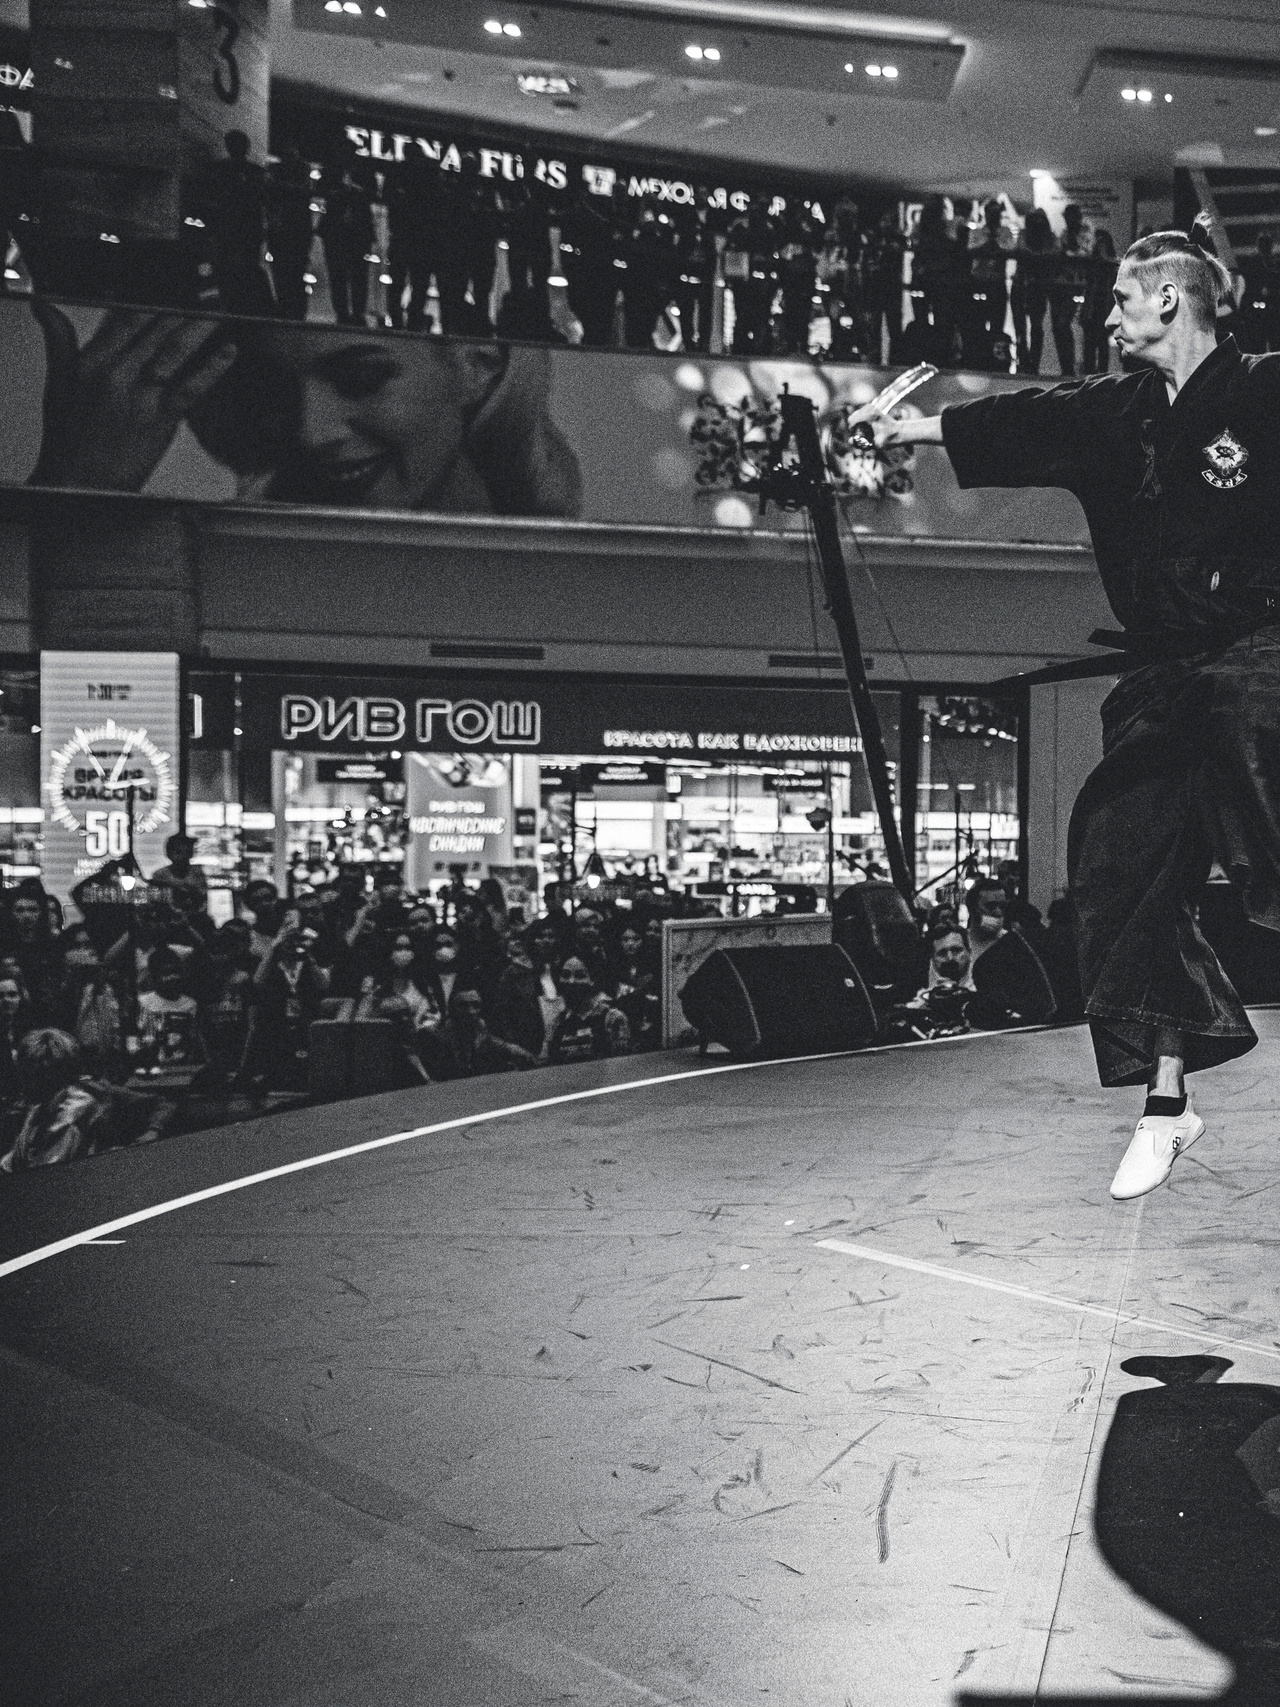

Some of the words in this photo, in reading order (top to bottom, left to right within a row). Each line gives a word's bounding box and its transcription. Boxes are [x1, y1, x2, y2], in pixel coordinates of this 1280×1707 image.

[281, 695, 406, 742] РИВ
[416, 698, 541, 745] ГОШ
[603, 730, 694, 749] КРАСОТА
[698, 732, 739, 750] КАК
